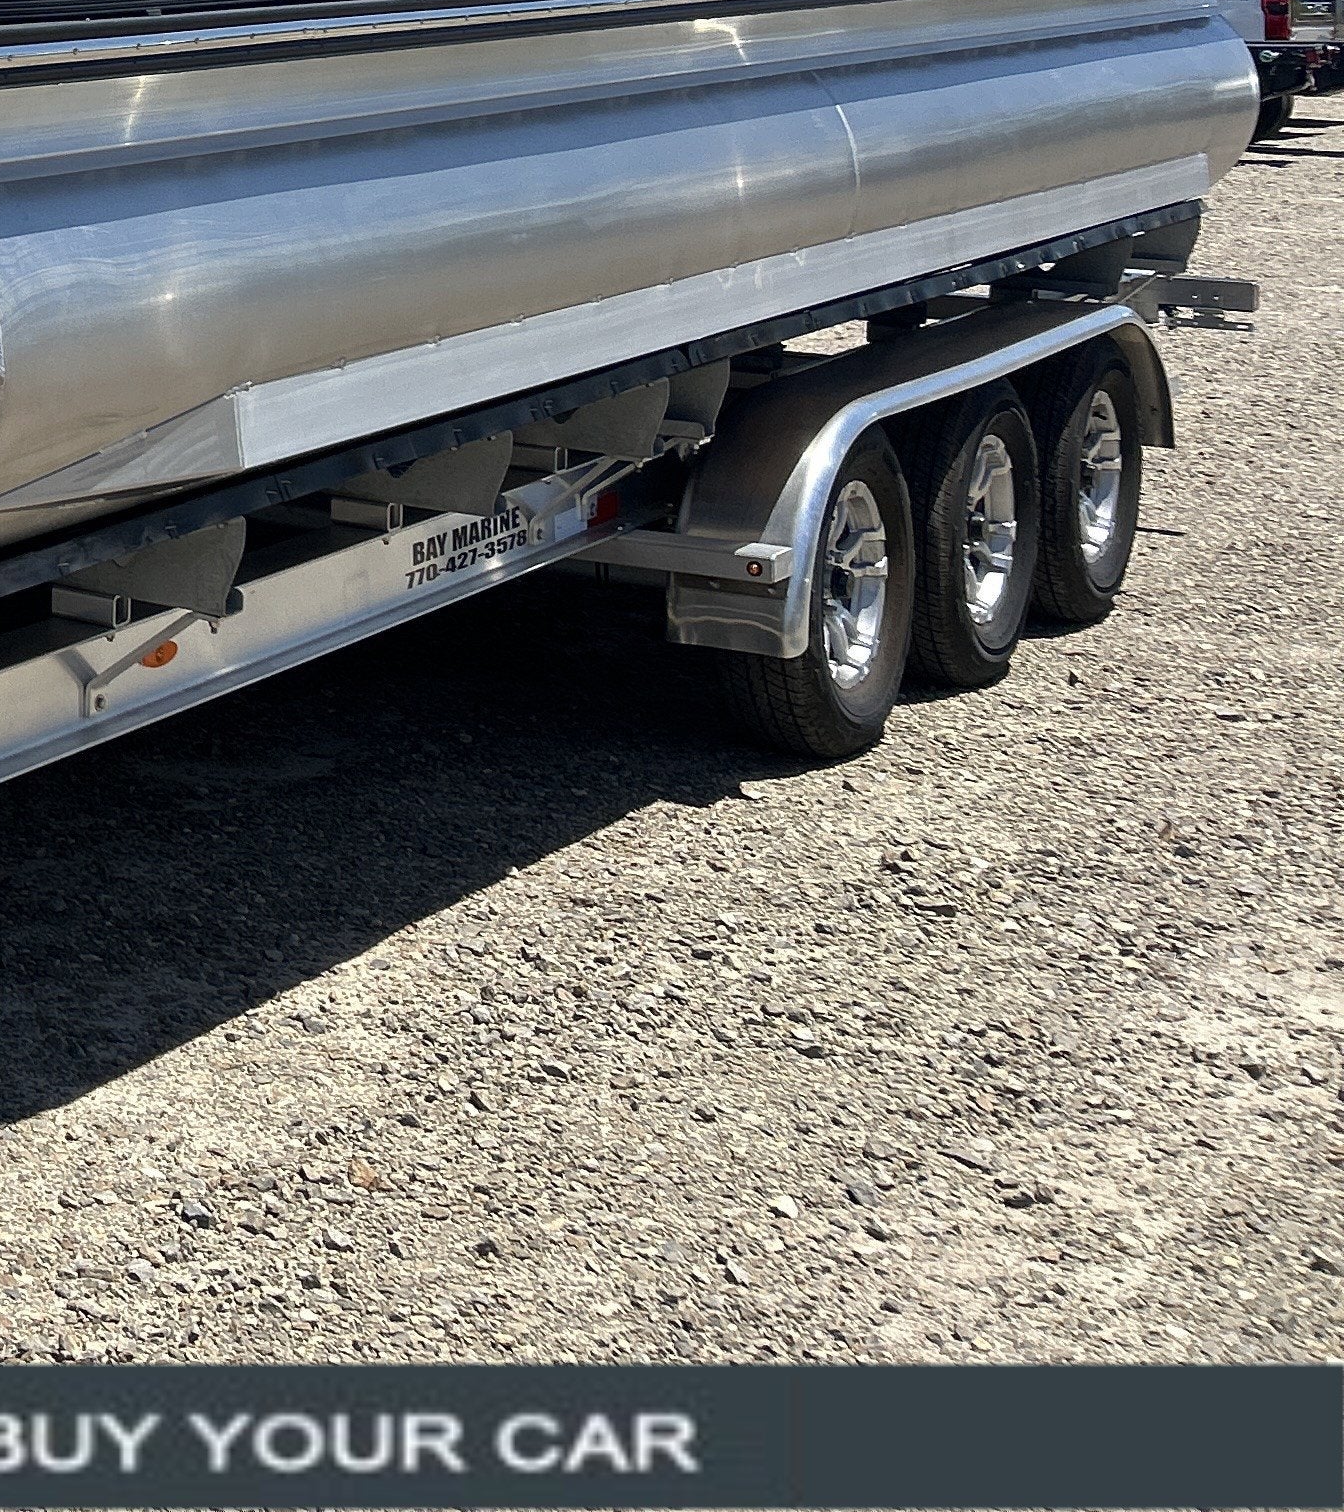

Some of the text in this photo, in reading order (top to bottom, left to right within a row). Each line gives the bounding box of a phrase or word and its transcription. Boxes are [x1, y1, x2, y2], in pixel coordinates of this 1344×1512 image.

[405, 528, 528, 590] 770-427-3578
[412, 506, 521, 567] BAY MARINE
